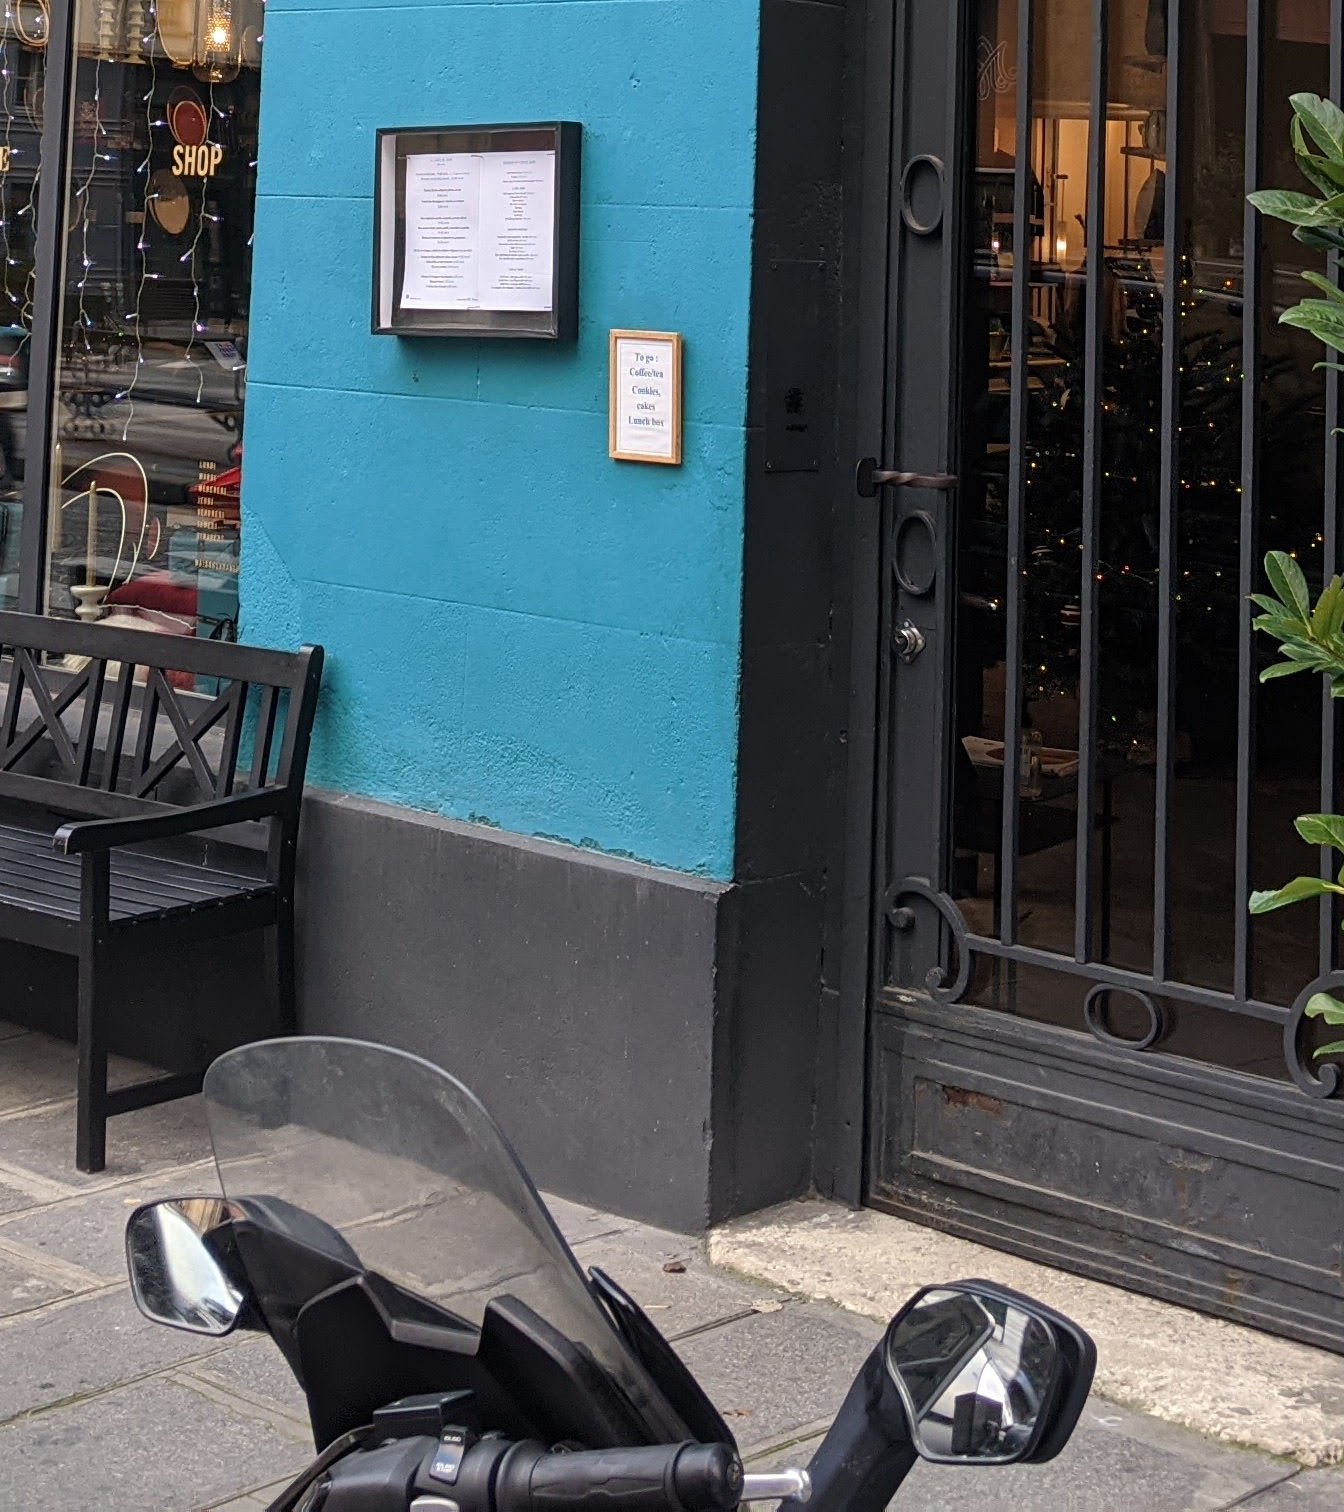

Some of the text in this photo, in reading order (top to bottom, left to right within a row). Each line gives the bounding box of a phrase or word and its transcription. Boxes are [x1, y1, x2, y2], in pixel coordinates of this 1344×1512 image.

[172, 144, 223, 177] SHOP
[635, 352, 644, 362] To
[645, 355, 654, 365] go
[629, 368, 664, 379] Coffee/tea
[636, 401, 655, 411] cakes
[628, 415, 664, 427] Lunch box
